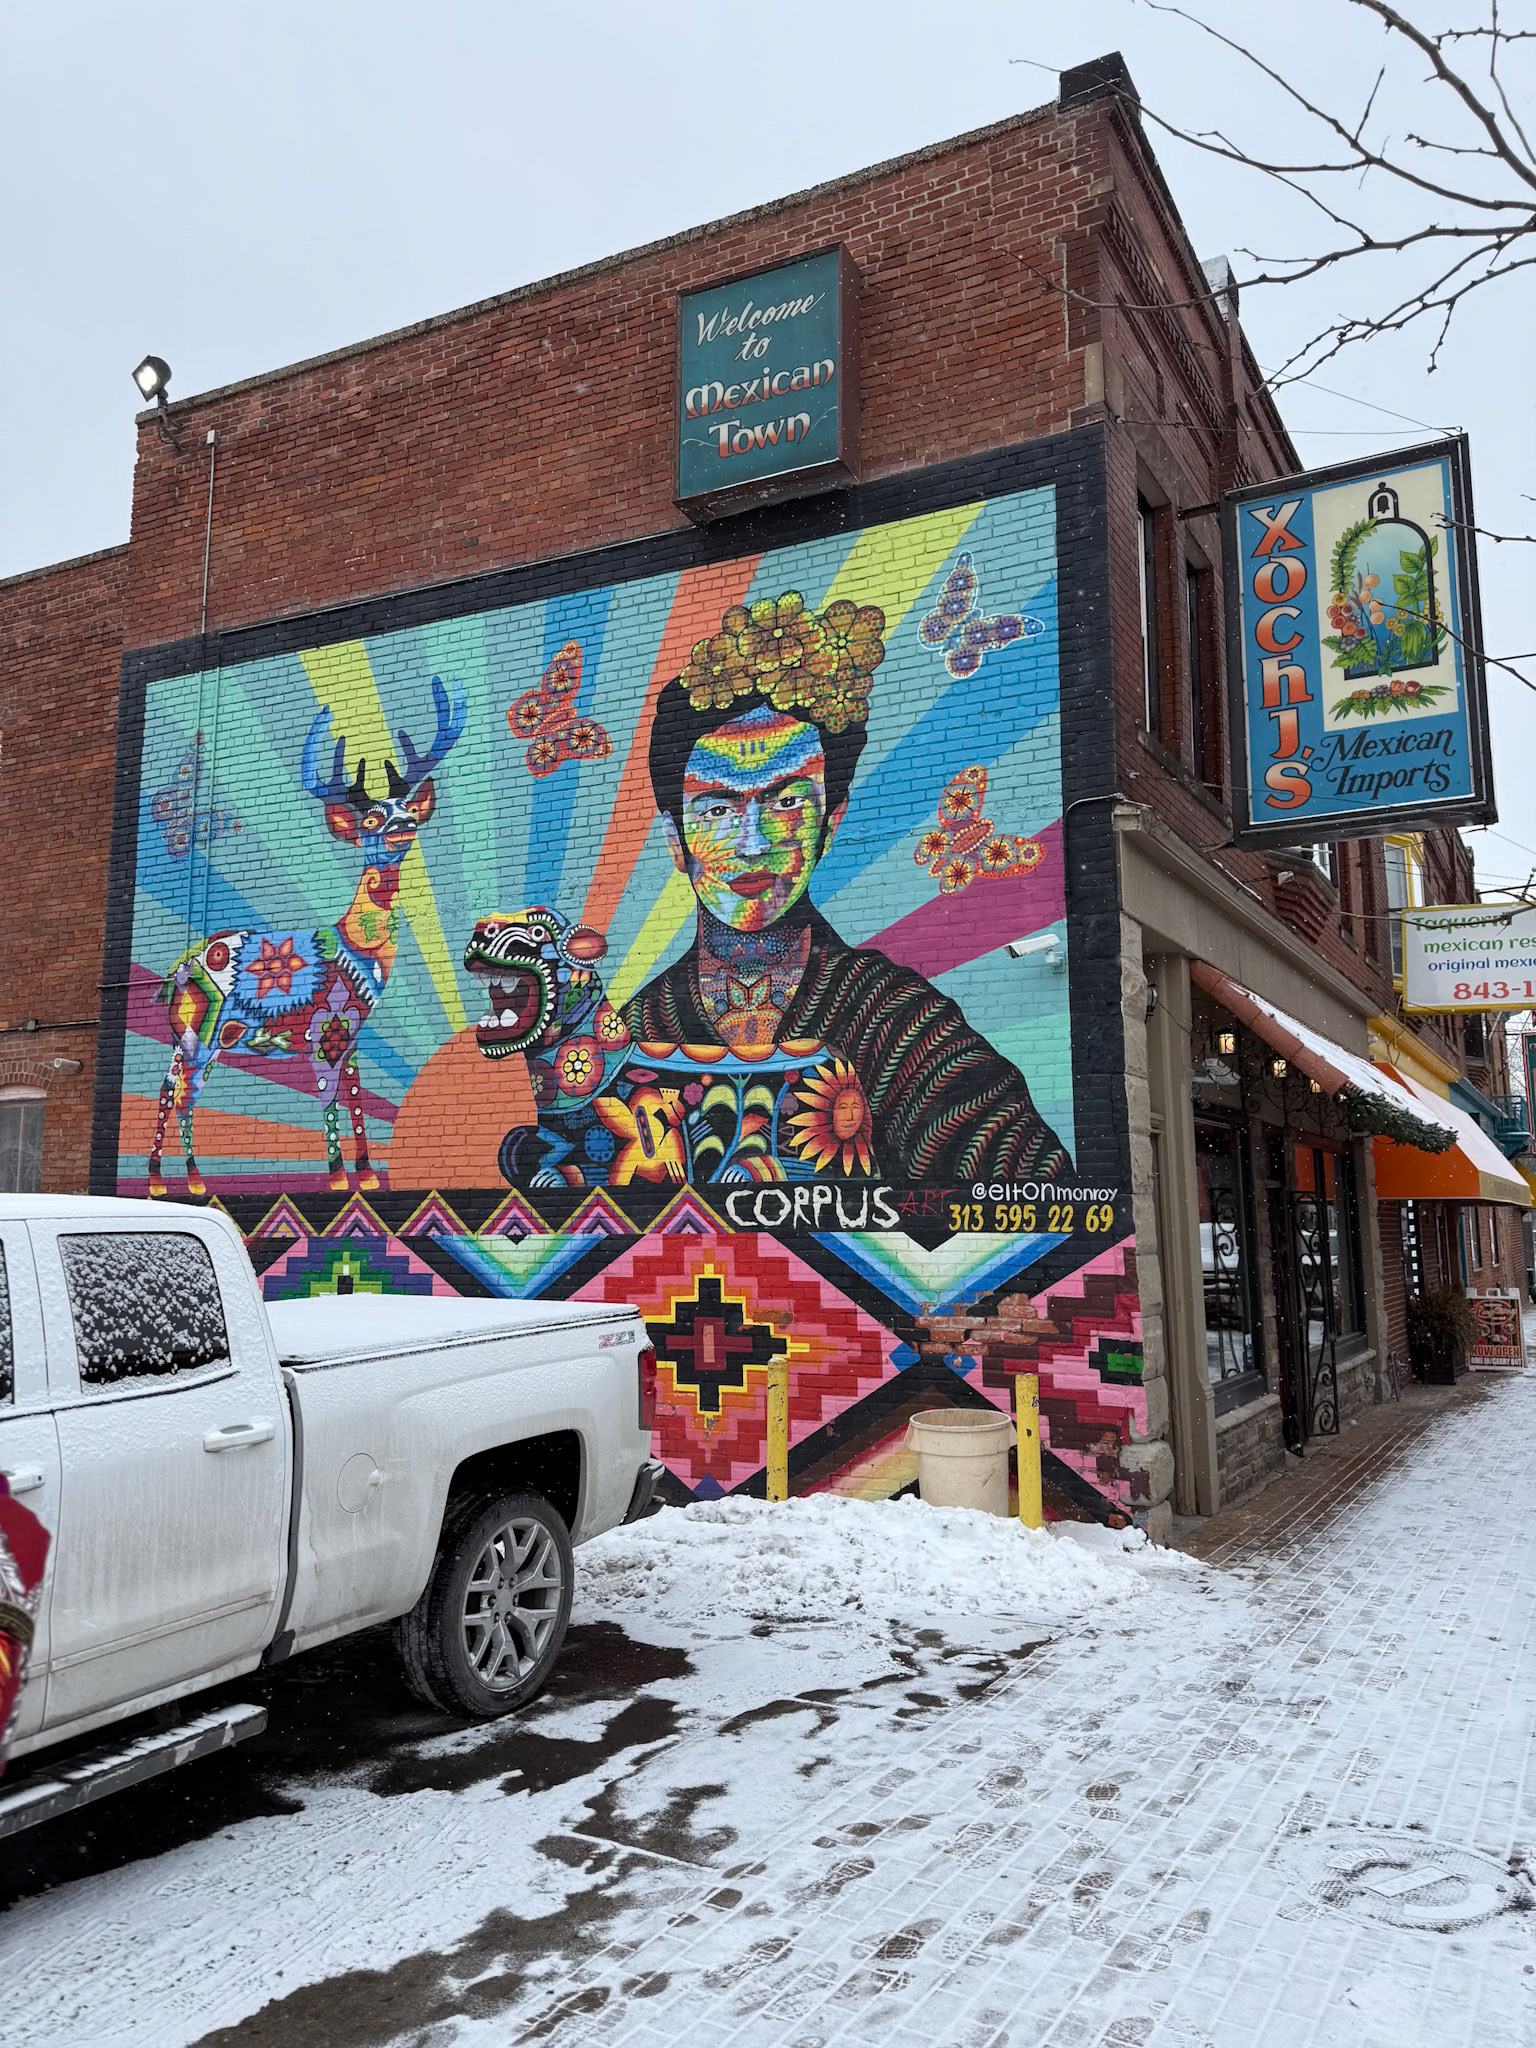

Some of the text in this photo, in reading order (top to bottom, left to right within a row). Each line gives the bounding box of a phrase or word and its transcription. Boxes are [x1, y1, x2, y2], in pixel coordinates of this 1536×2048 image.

[697, 292, 826, 346] Welcome
[735, 332, 773, 361] to
[685, 357, 835, 420] Mexican
[709, 412, 811, 458] Town
[1311, 728, 1456, 771] Mexican
[1326, 758, 1451, 799] Imports
[1424, 938, 1503, 954] mexican
[1428, 957, 1490, 973] original
[725, 1185, 960, 1229] CORPUS ART
[949, 1204, 1114, 1232] 313 595 22 69
